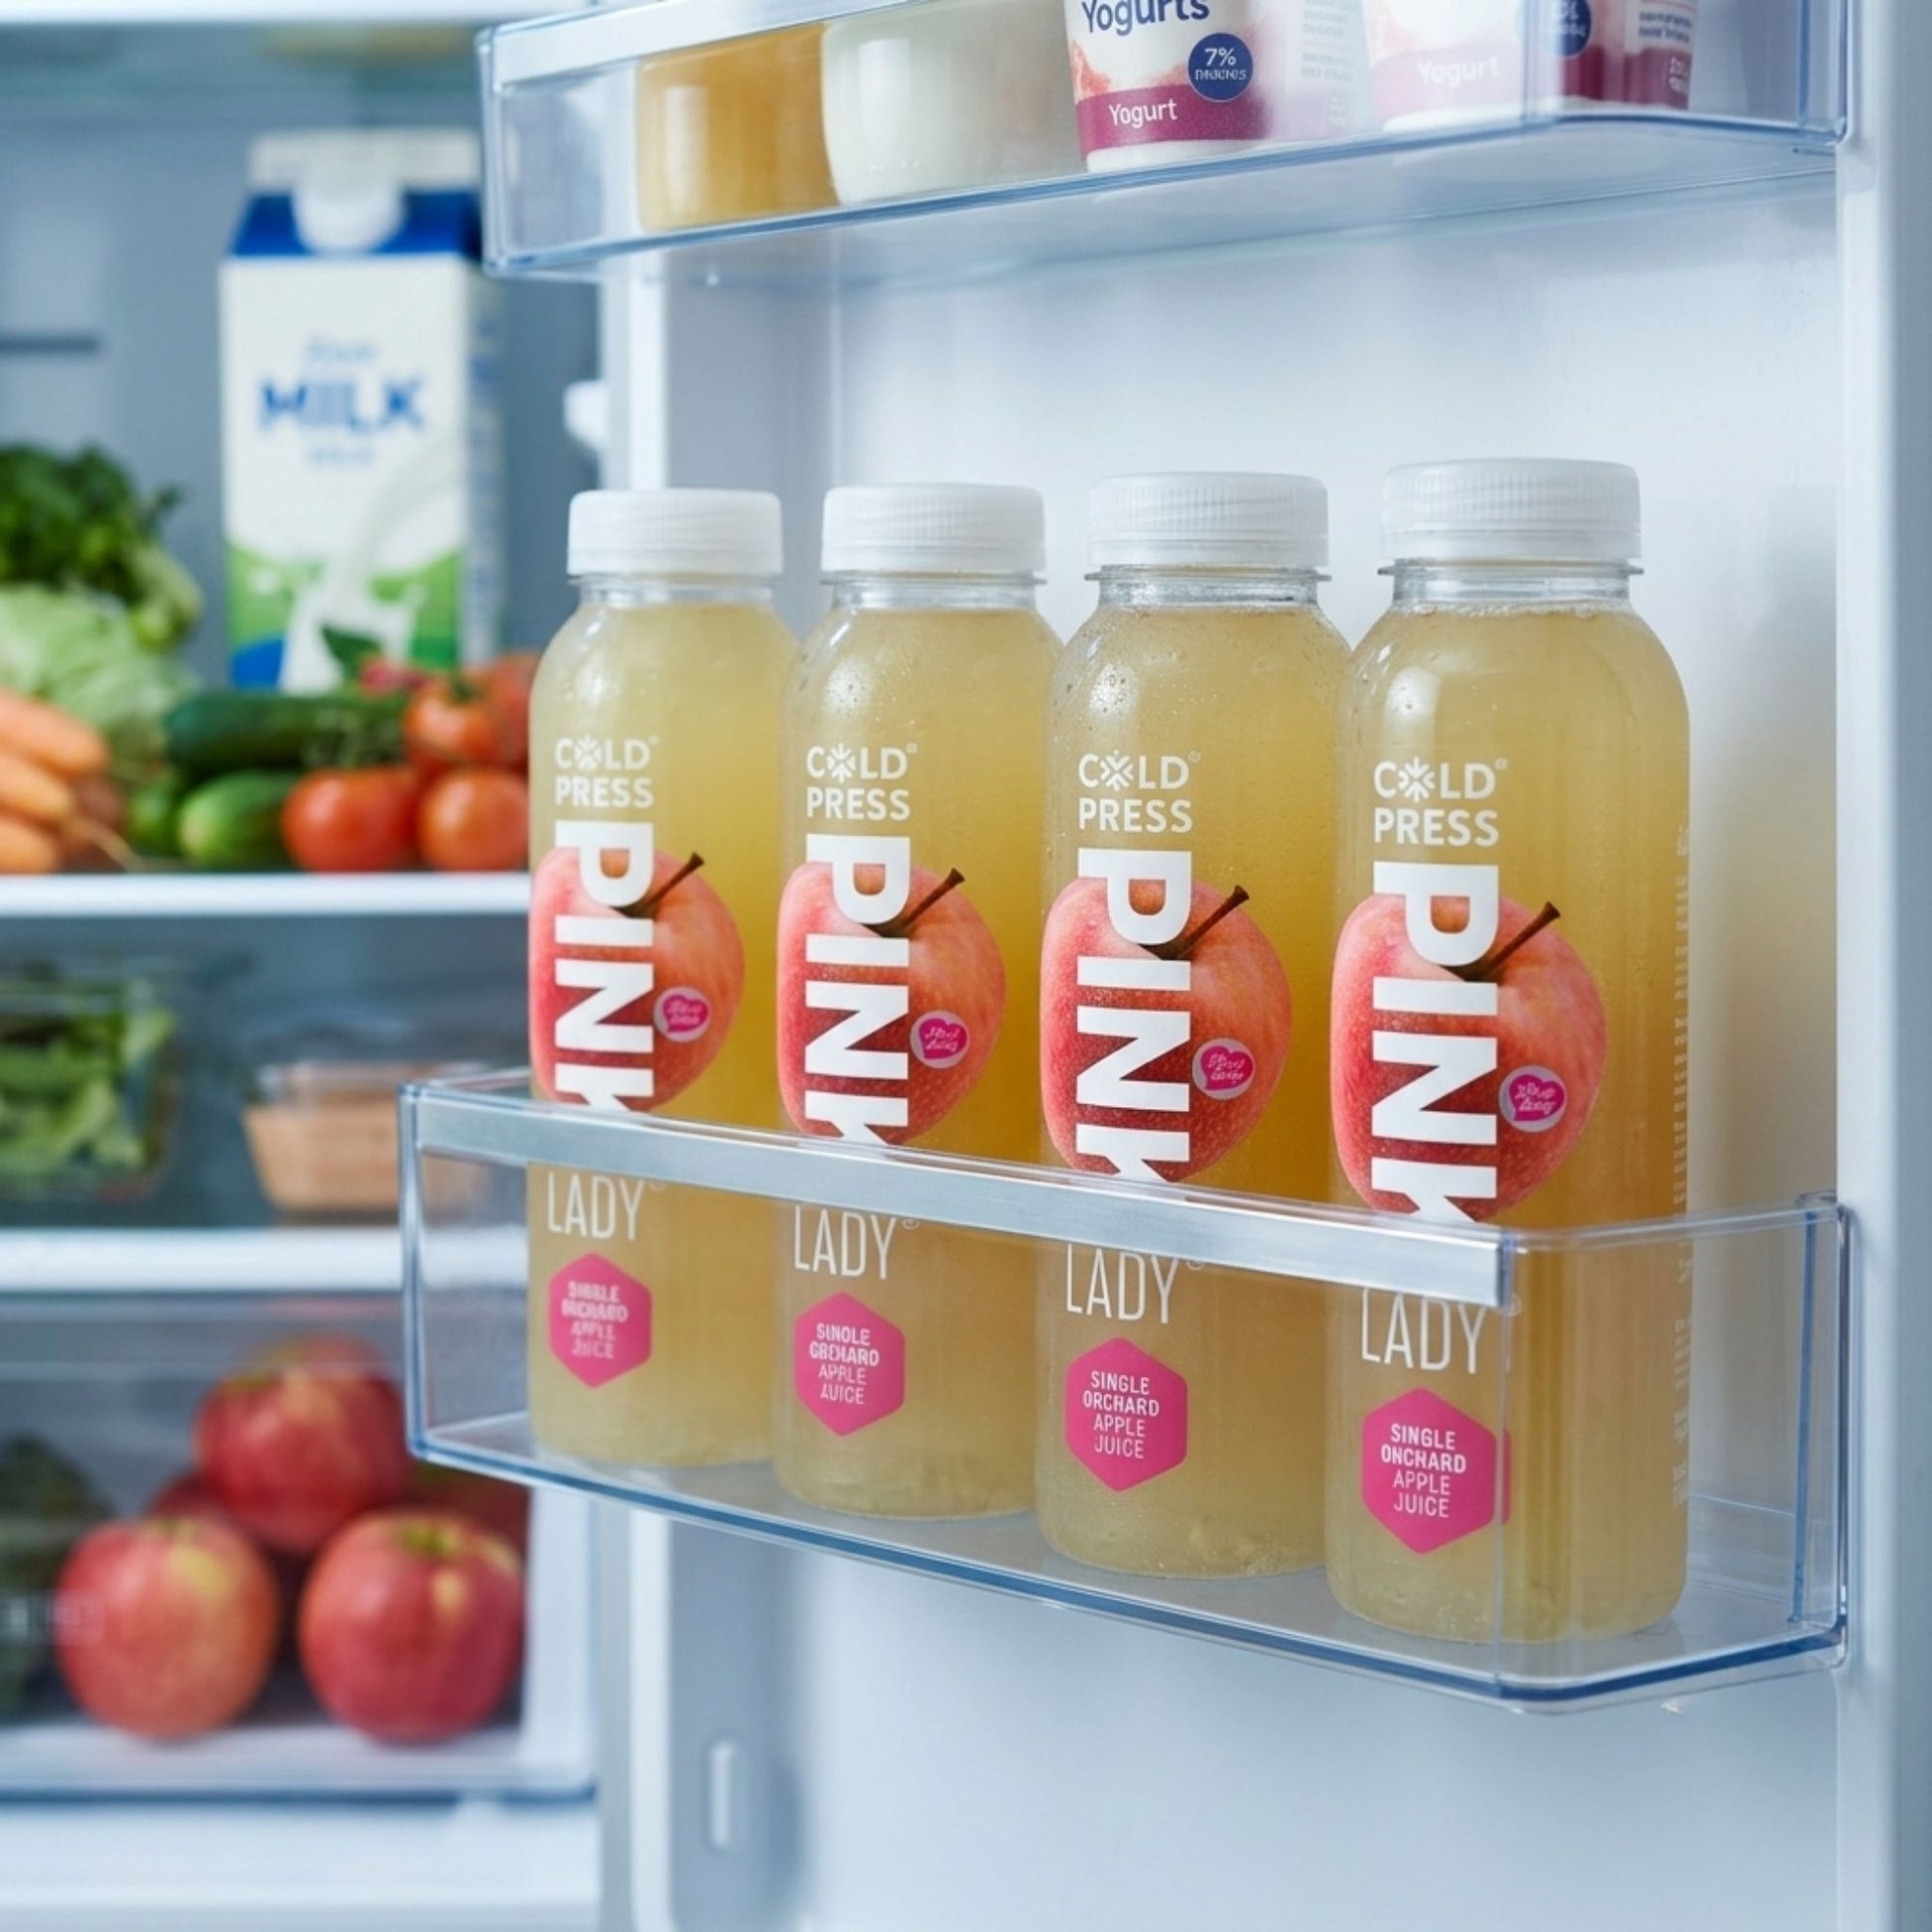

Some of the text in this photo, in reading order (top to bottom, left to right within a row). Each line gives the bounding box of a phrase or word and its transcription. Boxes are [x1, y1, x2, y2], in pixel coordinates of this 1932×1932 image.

[1204, 47, 1237, 67] 7%
[1417, 57, 1499, 87] Yogurt
[1109, 99, 1177, 129] Yogurt
[554, 775, 654, 809] PRESS
[806, 786, 910, 821] PRESS
[1078, 797, 1193, 833] PRESS
[1374, 807, 1499, 847] PRESS
[547, 1172, 644, 1240] LADY
[794, 1205, 897, 1280] LADY
[1066, 1243, 1178, 1323] LADY
[1361, 1288, 1486, 1374] LADY
[1091, 1370, 1150, 1395] SINGLE
[1083, 1390, 1160, 1417] ORCHARD
[1094, 1414, 1146, 1437] APPLE
[1391, 1423, 1455, 1450] SINGLE
[1094, 1435, 1144, 1458] JUICE
[1392, 1469, 1450, 1495] APPLE
[1394, 1492, 1449, 1518] JUICE
